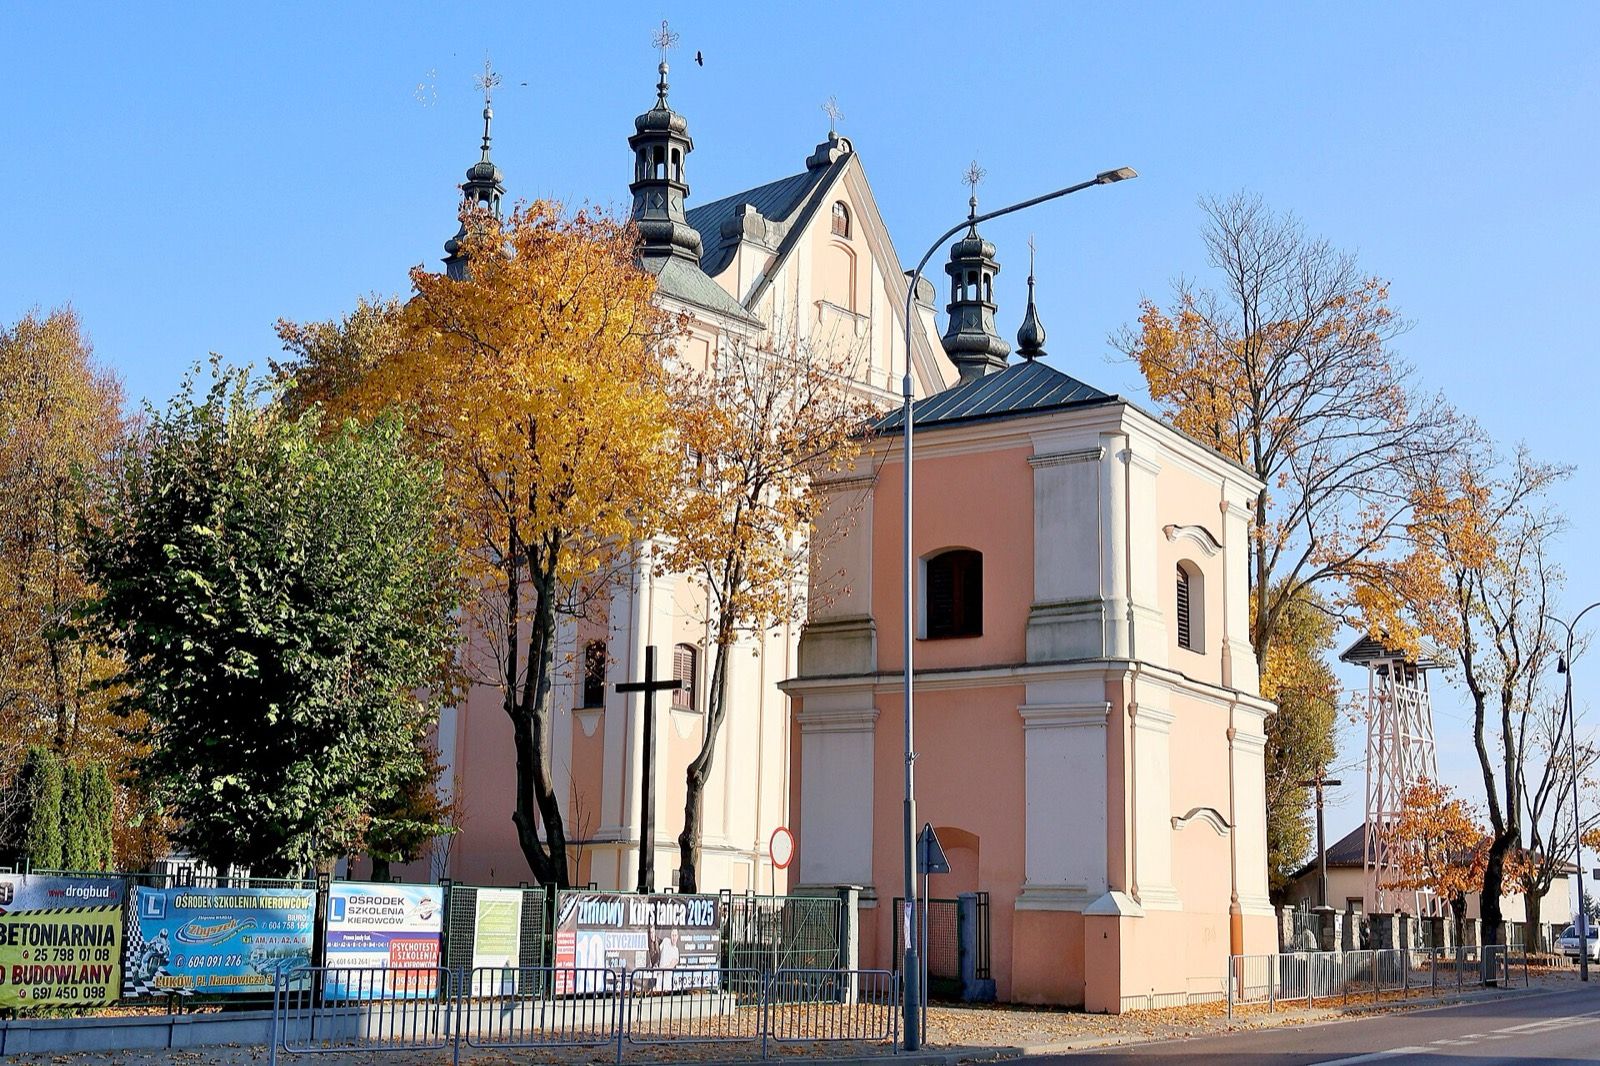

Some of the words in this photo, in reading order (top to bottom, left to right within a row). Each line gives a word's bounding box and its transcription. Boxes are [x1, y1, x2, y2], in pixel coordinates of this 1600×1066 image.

[175, 892, 212, 909] OŚRODEK
[213, 895, 258, 909] SZKOLENIA
[259, 896, 309, 909] KIEROWCÓW
[349, 895, 405, 905] OŚRODEK
[348, 907, 405, 915] SZKOLENIA
[578, 900, 625, 927] zimowy
[629, 898, 656, 926] kurs
[656, 898, 686, 926] tańca
[687, 899, 714, 926] 2025
[347, 916, 404, 925] KIEROWCÓW
[0, 923, 115, 946] BETONIARNIA
[392, 942, 438, 951] PSYCHOTESTY
[606, 934, 646, 949] STYCZNIA
[34, 950, 48, 962] 25
[53, 949, 74, 962] 798
[79, 949, 90, 961] 01
[94, 949, 110, 962] 08
[188, 955, 204, 968] 604
[206, 955, 222, 967] 091
[224, 955, 242, 967] 276
[397, 952, 437, 960] SZKOLENIA
[12, 965, 113, 985] BUDOWLANY
[208, 974, 265, 986] Narutowicza
[266, 974, 274, 985] 3
[55, 987, 78, 999] 450
[83, 986, 106, 999] 098
